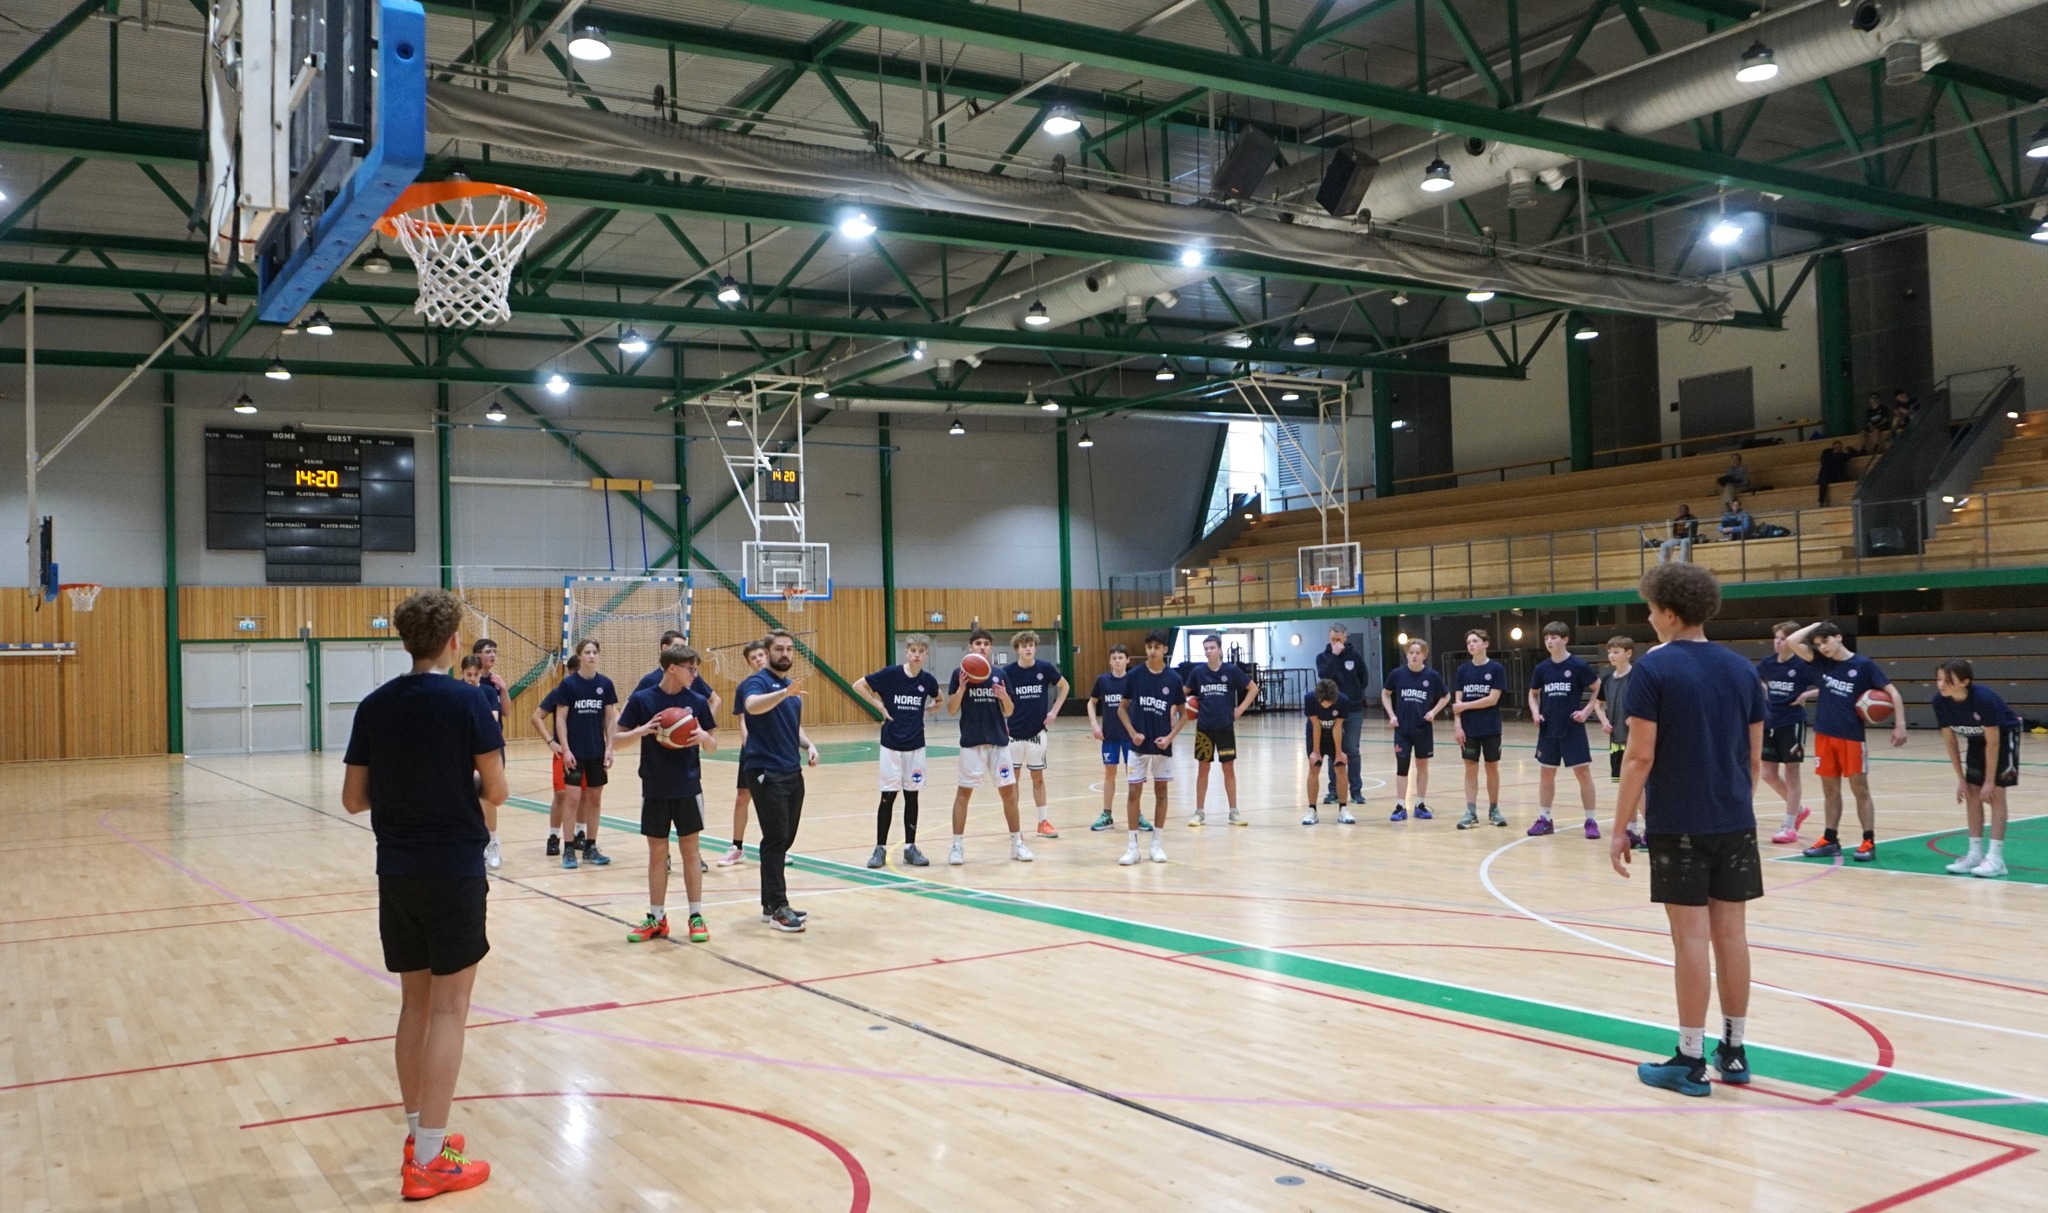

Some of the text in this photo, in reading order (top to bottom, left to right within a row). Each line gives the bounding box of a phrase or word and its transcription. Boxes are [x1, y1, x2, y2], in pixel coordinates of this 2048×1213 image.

[272, 432, 296, 440] HOME
[327, 434, 352, 442] GUEST
[296, 470, 338, 488] 14:20
[1015, 685, 1042, 695] NORGE
[1200, 683, 1228, 693] NORGE
[1463, 684, 1491, 693] NORGE
[1544, 682, 1571, 693] NORGE
[969, 688, 996, 698] NORG
[1401, 688, 1428, 700] NORGE
[894, 694, 923, 706] NORGE
[1104, 694, 1122, 703] NOR
[1139, 696, 1168, 711] NORGE
[574, 699, 603, 709] NORGE
